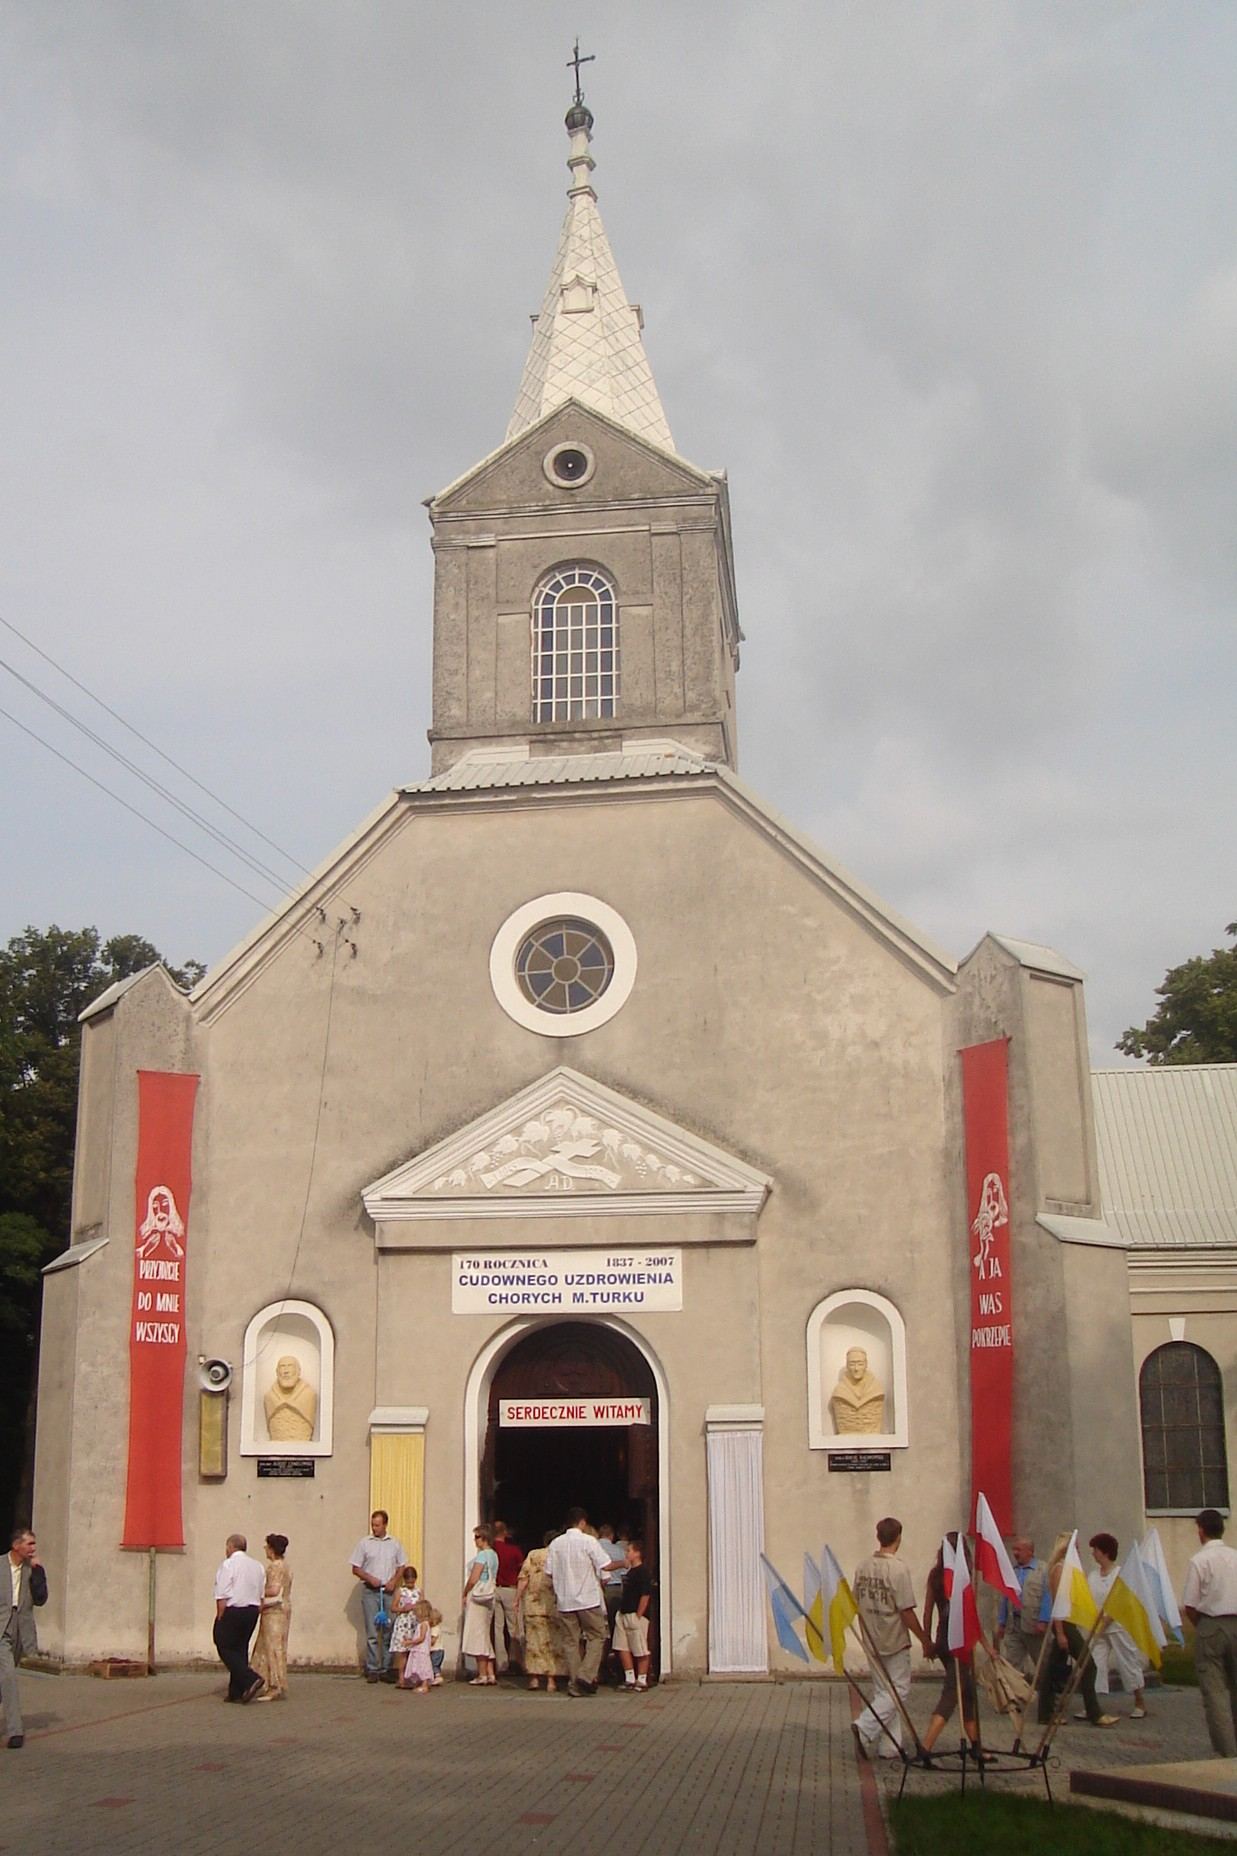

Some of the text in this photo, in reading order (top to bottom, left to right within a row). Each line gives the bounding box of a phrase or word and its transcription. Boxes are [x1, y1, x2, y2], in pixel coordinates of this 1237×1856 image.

[460, 1259, 548, 1269] 170 ROCZNICA
[606, 1257, 634, 1267] 1837
[645, 1256, 675, 1267] 2007
[459, 1272, 674, 1286] CUDOWNEGO UZDROWIENIA
[138, 1291, 180, 1312] DO MNIE
[488, 1291, 645, 1304] CHORYCH M.TURKU
[979, 1291, 1003, 1315] WAS
[136, 1321, 180, 1344] WSZYSCY
[507, 1405, 643, 1420] SERDECZNIE WITAMY
